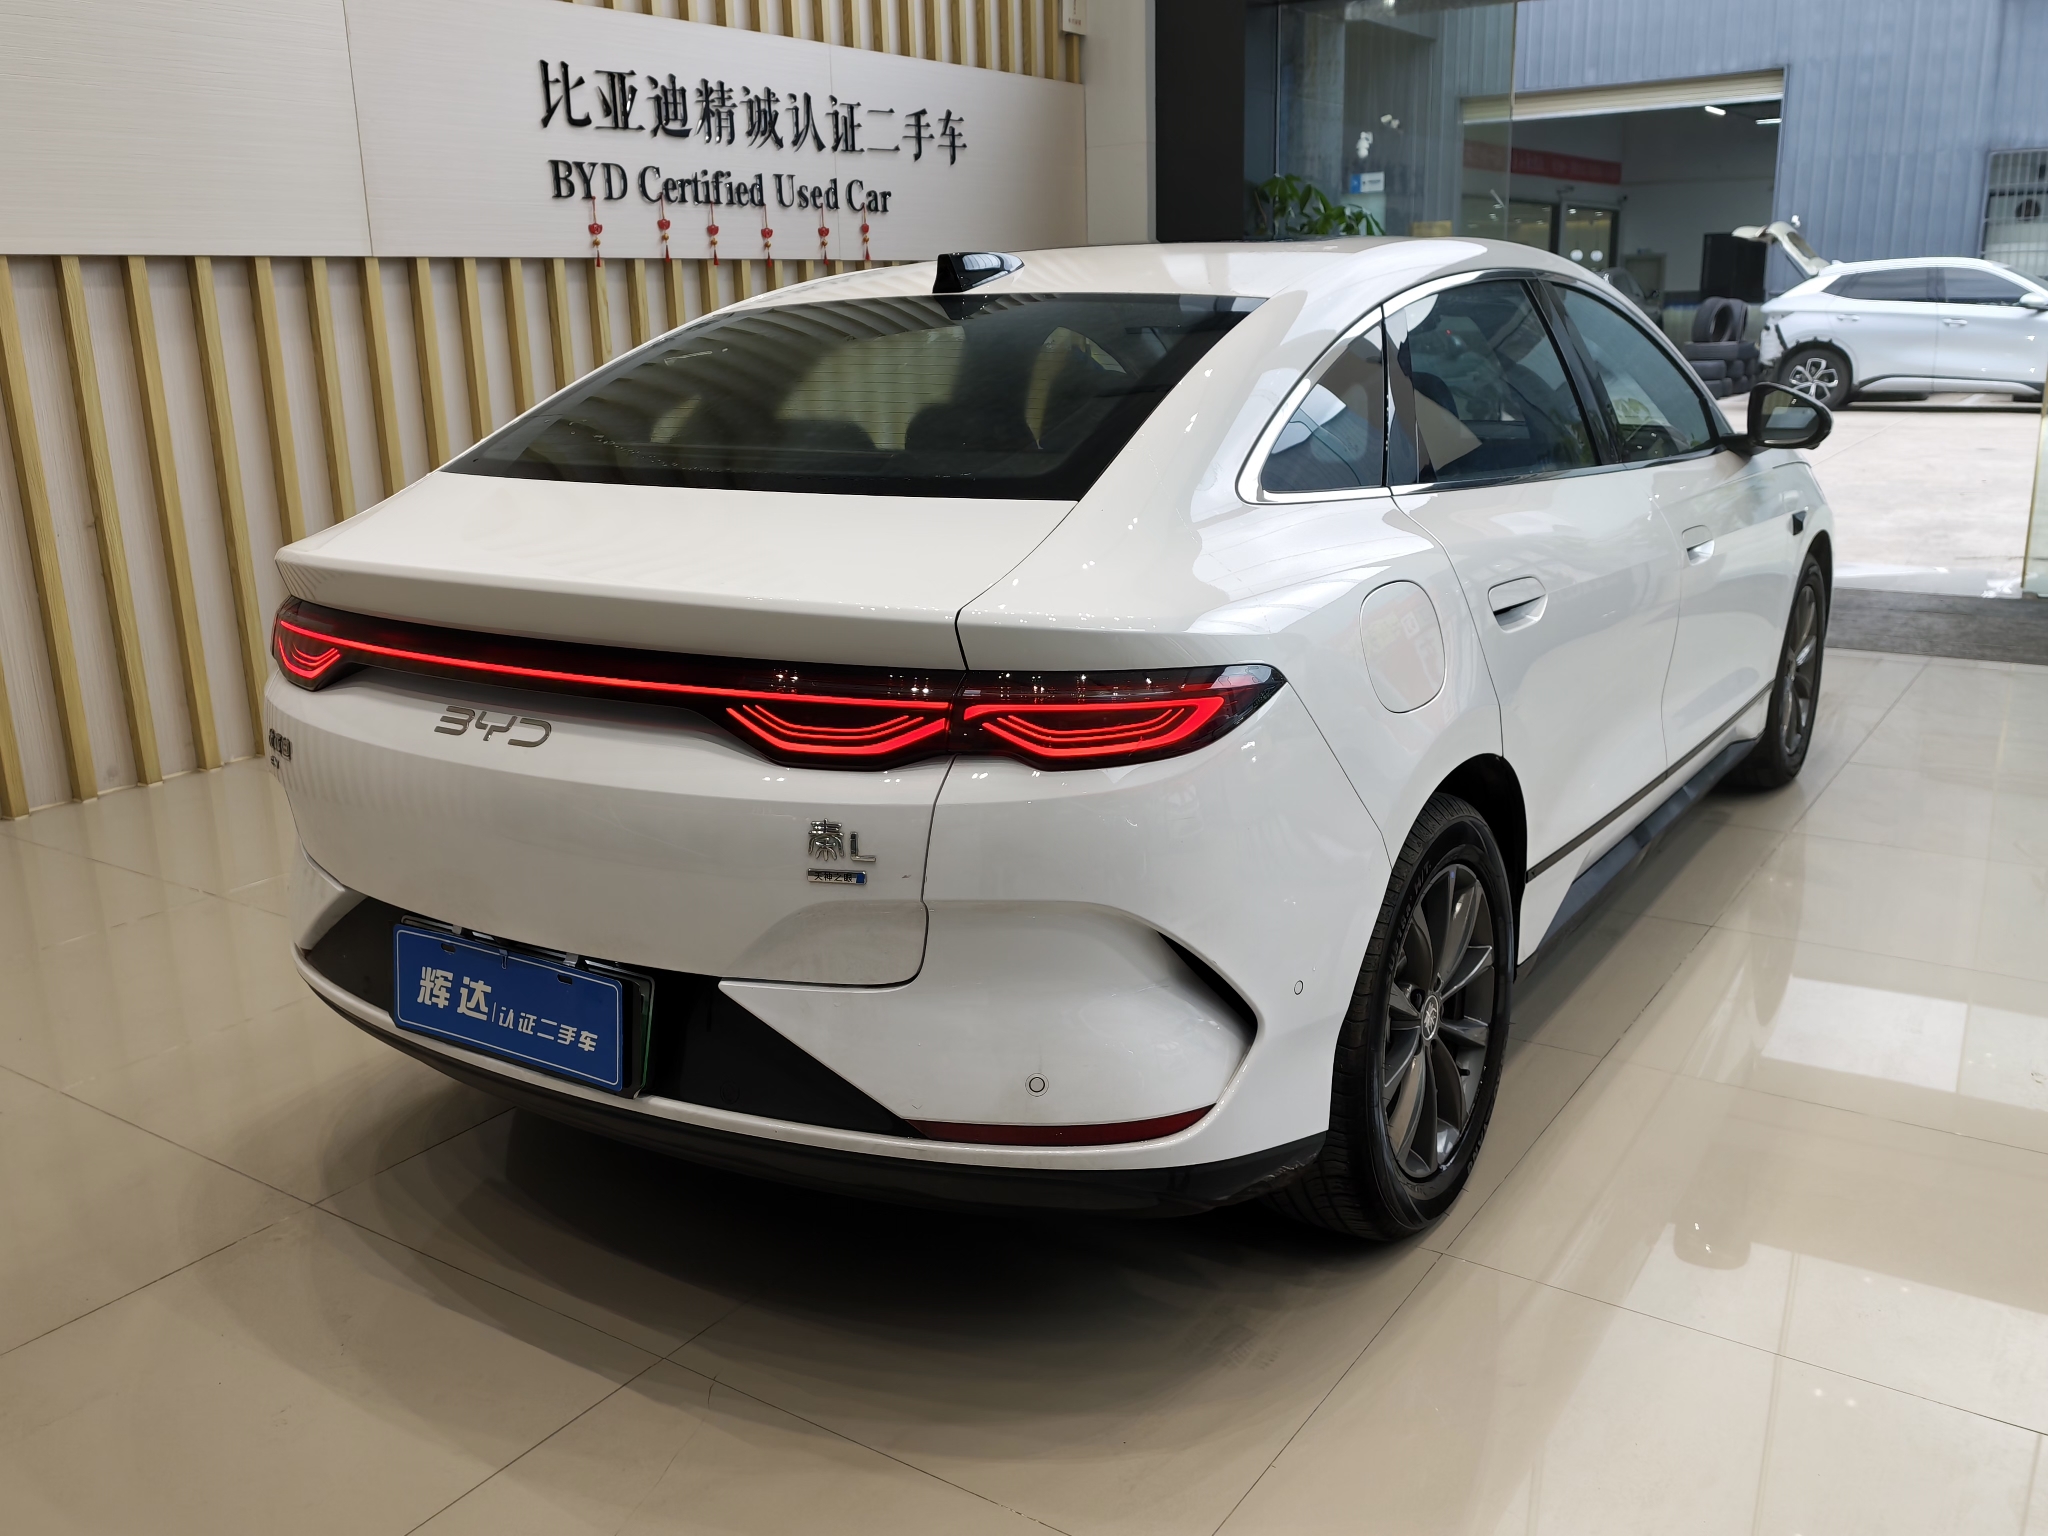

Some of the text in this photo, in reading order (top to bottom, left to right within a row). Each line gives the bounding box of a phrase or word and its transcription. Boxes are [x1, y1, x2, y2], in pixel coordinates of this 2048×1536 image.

[539, 59, 967, 166] 比亚迪精诚认证二手车
[548, 159, 892, 213] BYD Certified Used Car
[434, 705, 552, 748] BYD
[417, 966, 598, 1052] 辉达 认证二手车
